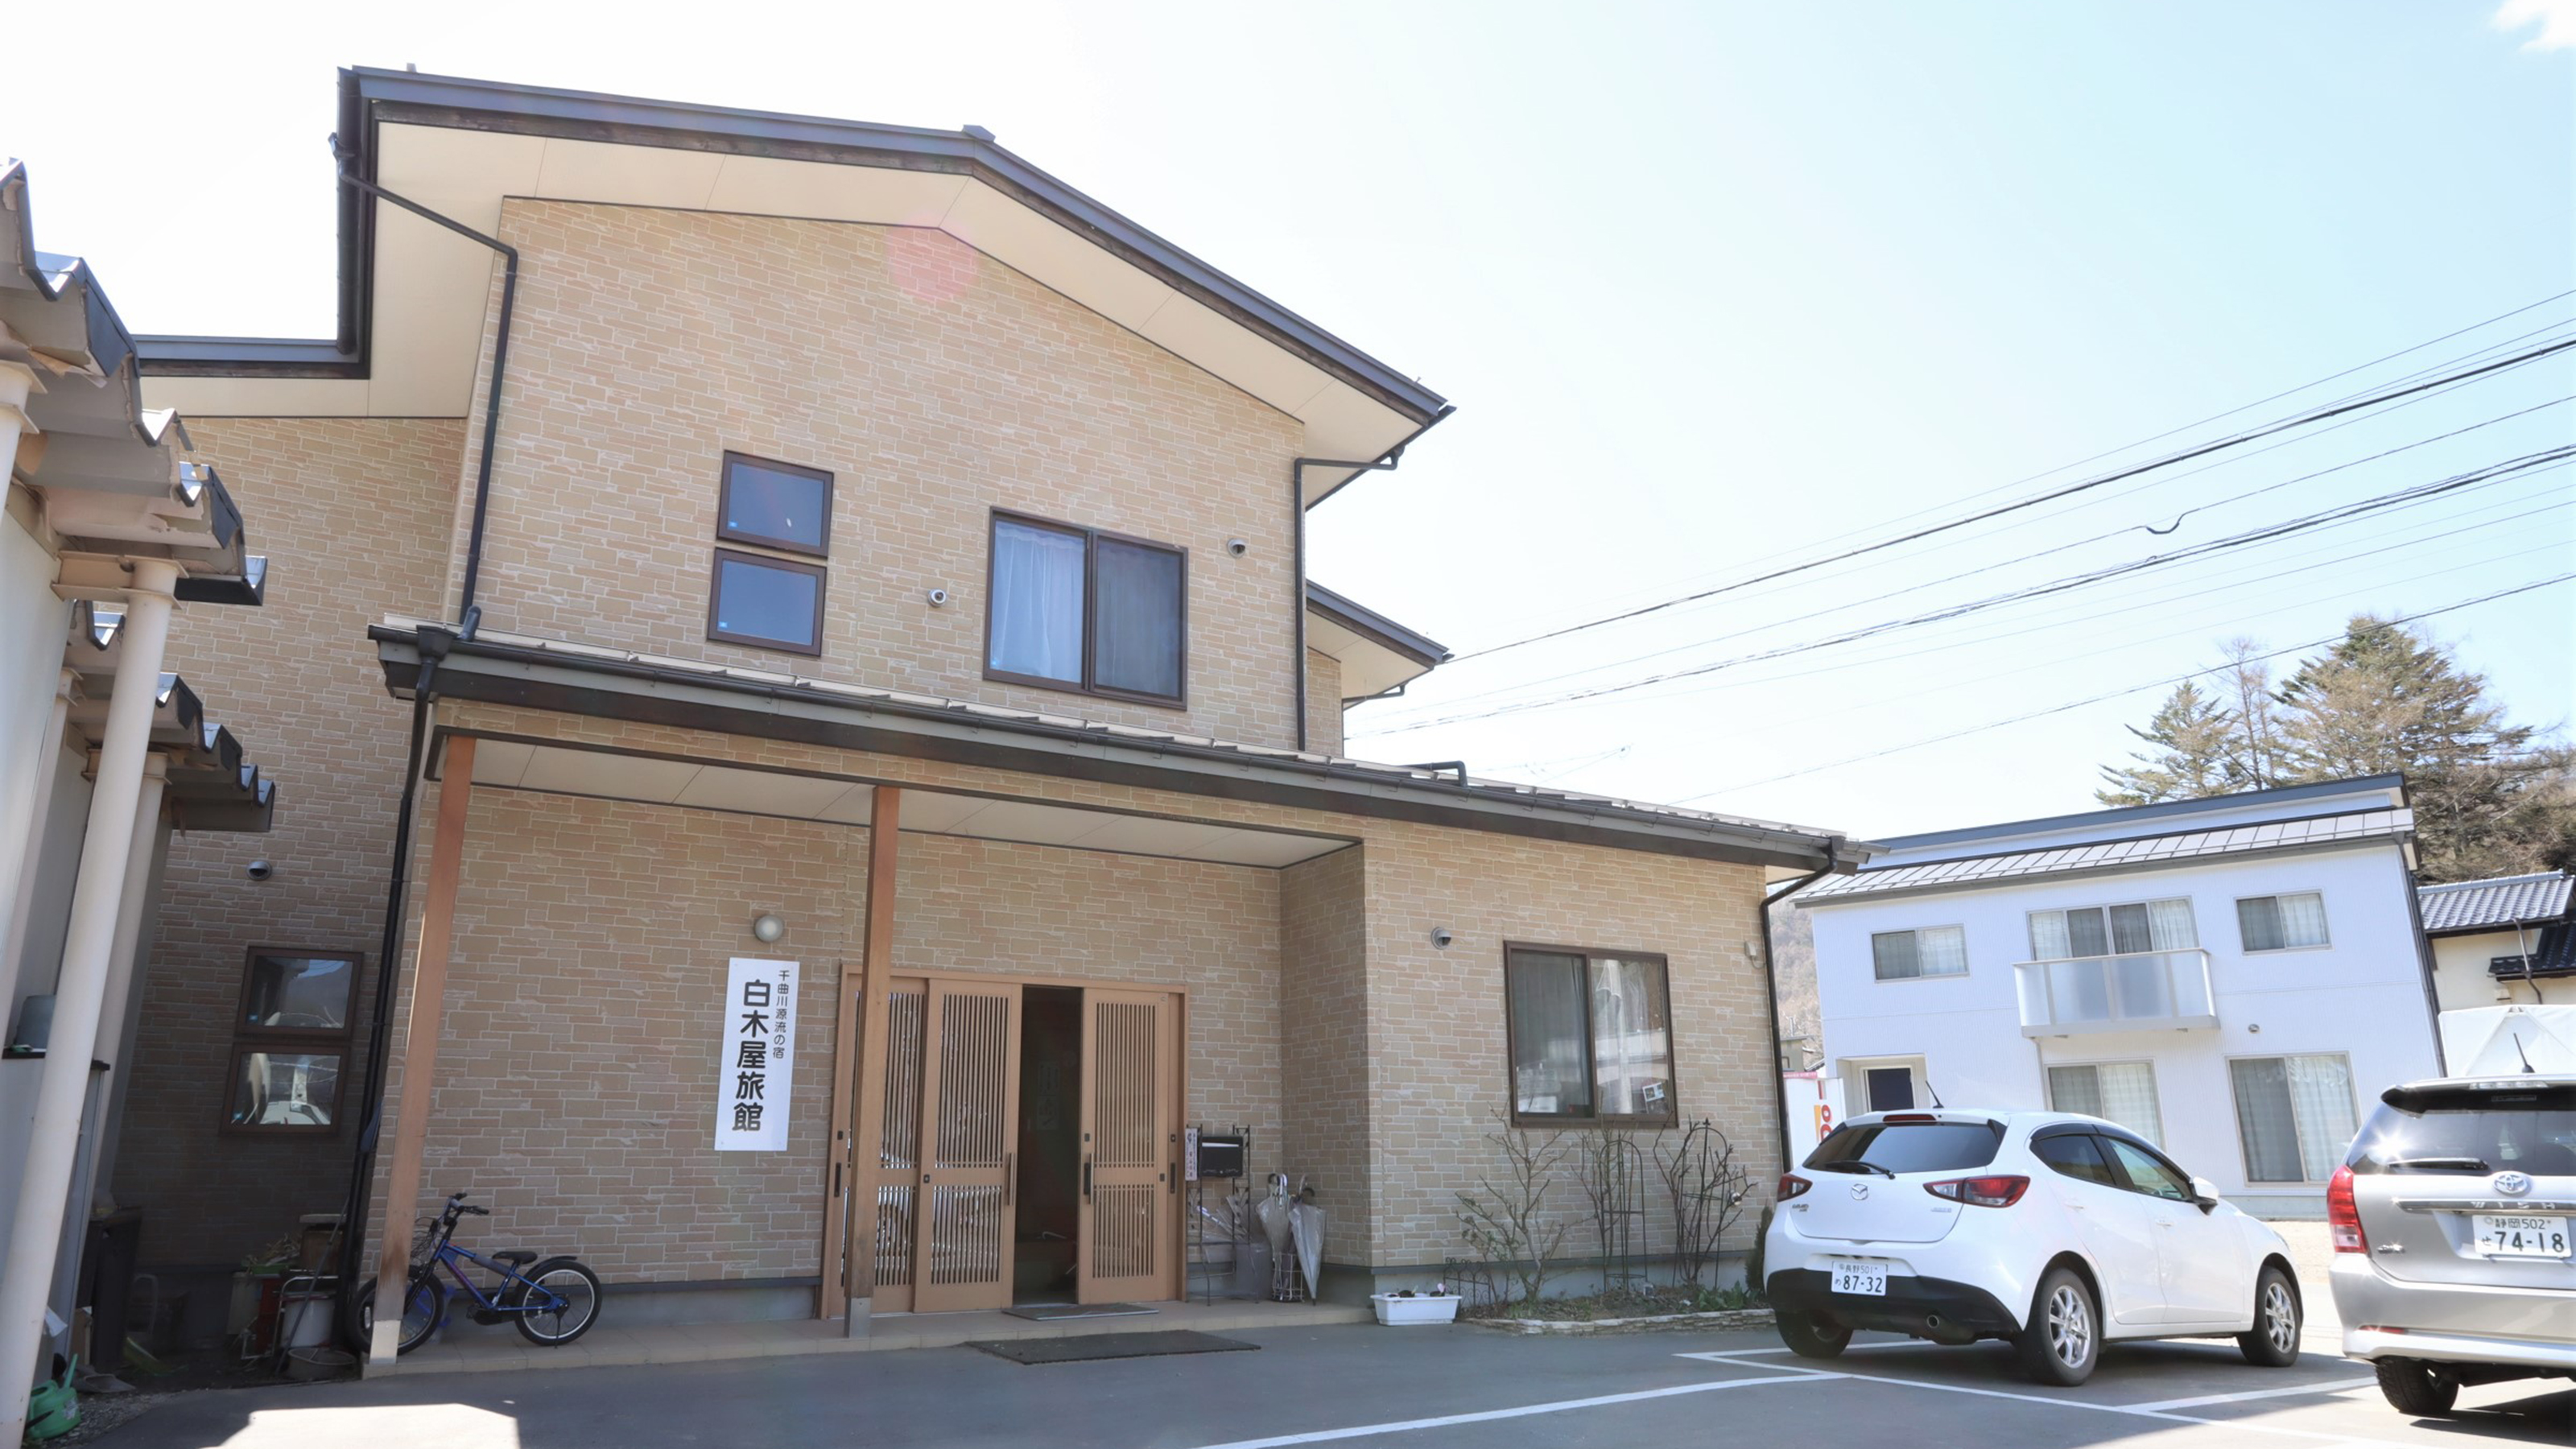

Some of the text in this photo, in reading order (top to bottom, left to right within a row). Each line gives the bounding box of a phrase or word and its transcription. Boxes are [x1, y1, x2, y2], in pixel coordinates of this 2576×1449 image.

[772, 970, 790, 1059] 千曲川源流の宿
[732, 979, 771, 1131] 白木屋旅館
[2495, 1218, 2545, 1230] 静岡502
[2495, 1232, 2564, 1253] 74-18
[1843, 1274, 1883, 1293] 87-32
